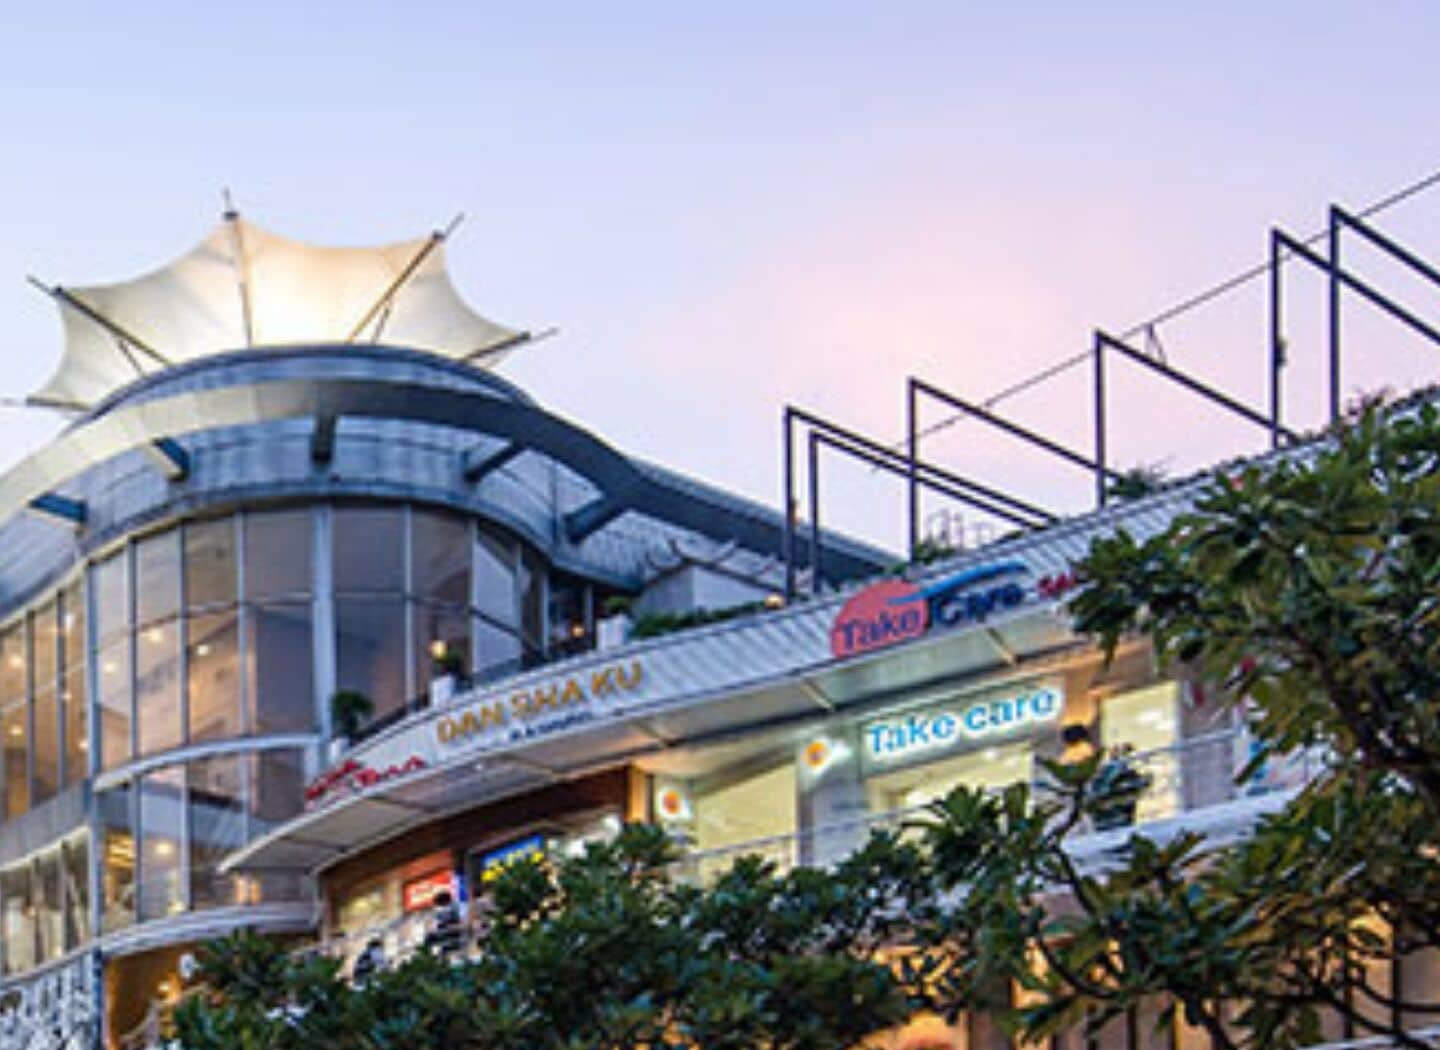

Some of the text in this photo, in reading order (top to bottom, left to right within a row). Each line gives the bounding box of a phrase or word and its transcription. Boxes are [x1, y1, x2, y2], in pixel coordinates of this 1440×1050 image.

[840, 606, 921, 650] Take
[436, 702, 504, 744] DAN
[591, 660, 644, 698] KU
[868, 689, 1056, 754] Take care
